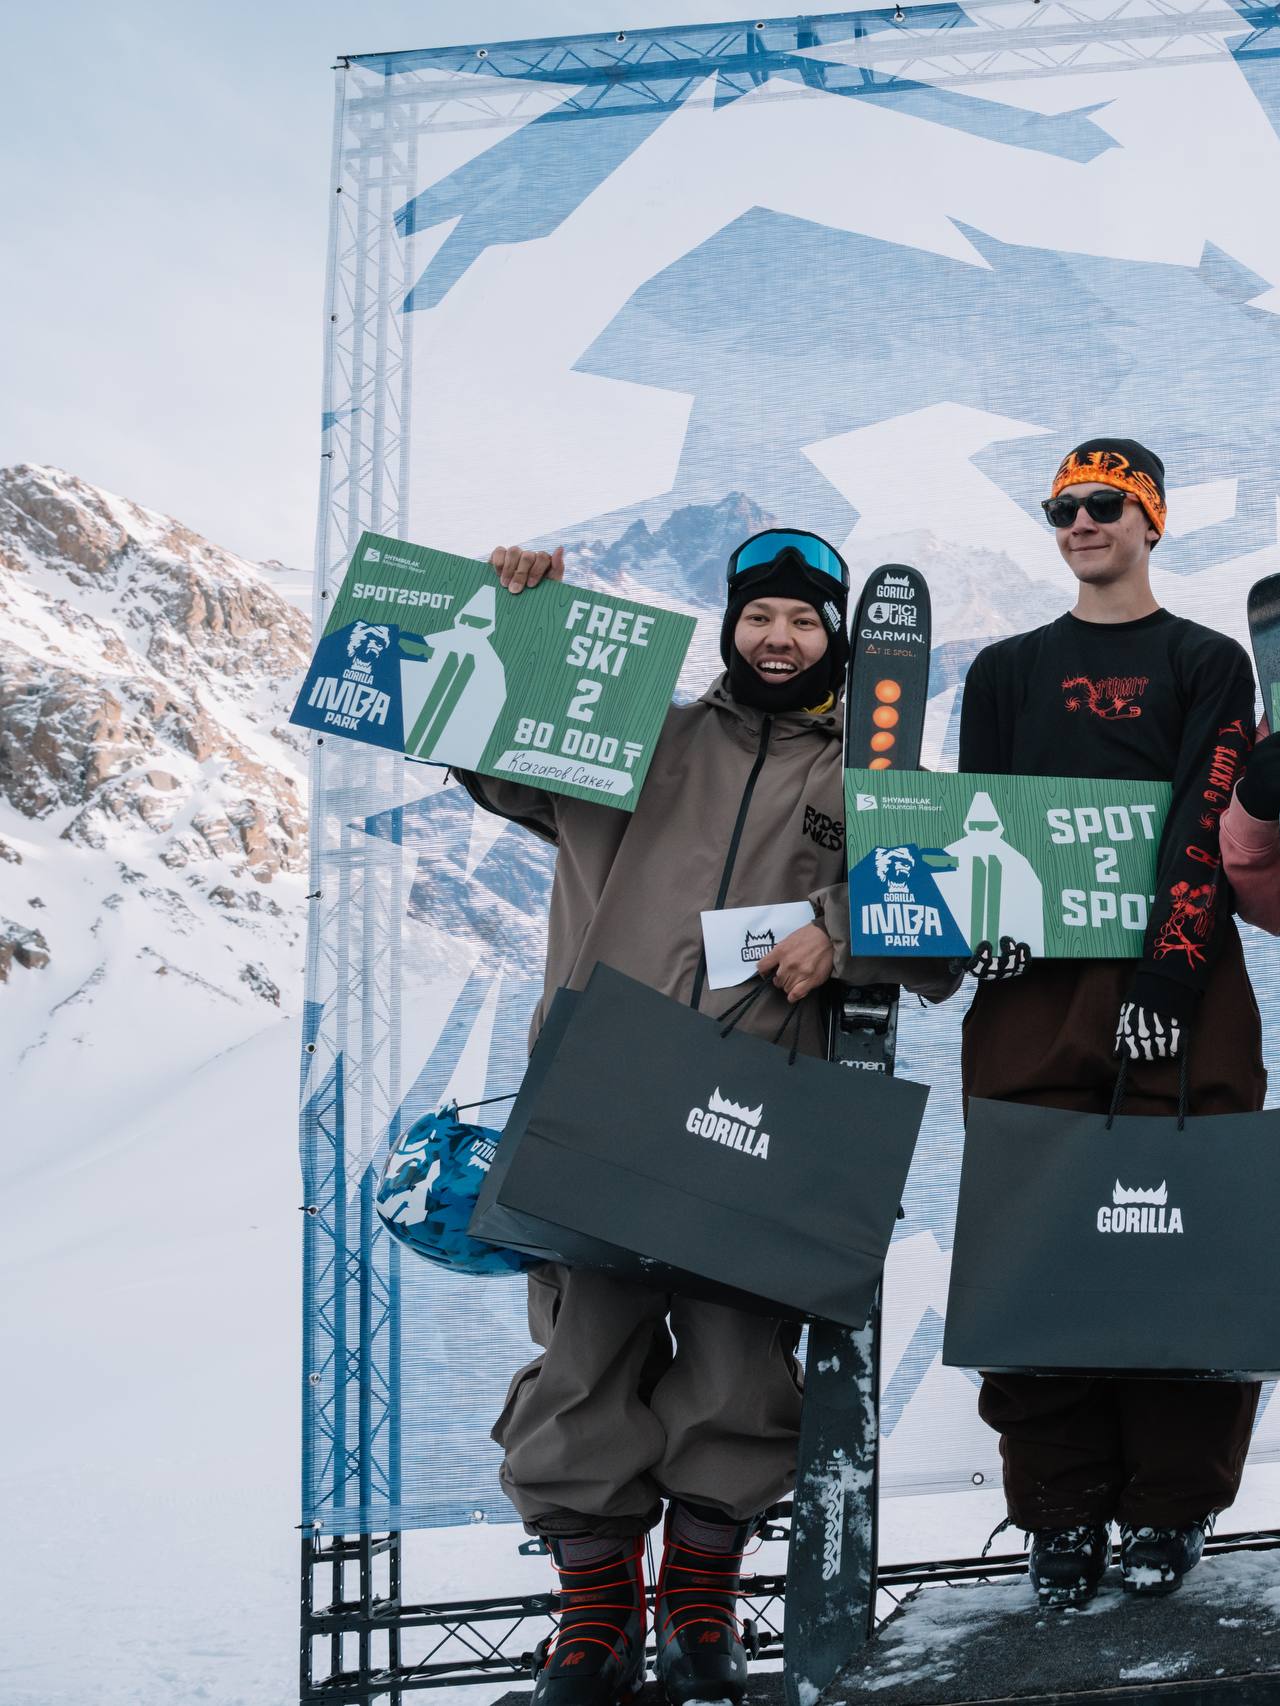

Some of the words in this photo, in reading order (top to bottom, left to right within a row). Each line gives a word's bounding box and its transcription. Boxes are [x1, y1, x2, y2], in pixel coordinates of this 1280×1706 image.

[352, 583, 454, 610] SPOT2SPOT
[876, 585, 915, 600] GORILLA
[565, 600, 655, 646] FREE
[565, 635, 628, 676] SKI
[342, 668, 374, 685] GORILLA
[307, 676, 391, 726] IMBA
[566, 678, 603, 722] 2
[324, 711, 360, 731] PARK
[513, 717, 555, 749] 80
[572, 766, 614, 790] Сакен
[1047, 804, 1157, 844] SPOT
[1094, 847, 1120, 883] 2
[883, 893, 915, 903] GORILLA
[1061, 889, 1155, 930] SPO
[862, 904, 943, 936] IMBA
[743, 946, 774, 961] GORIL
[885, 935, 920, 947] PARK
[685, 1107, 770, 1160] GORILLA
[1096, 1206, 1184, 1233] GORILLA
